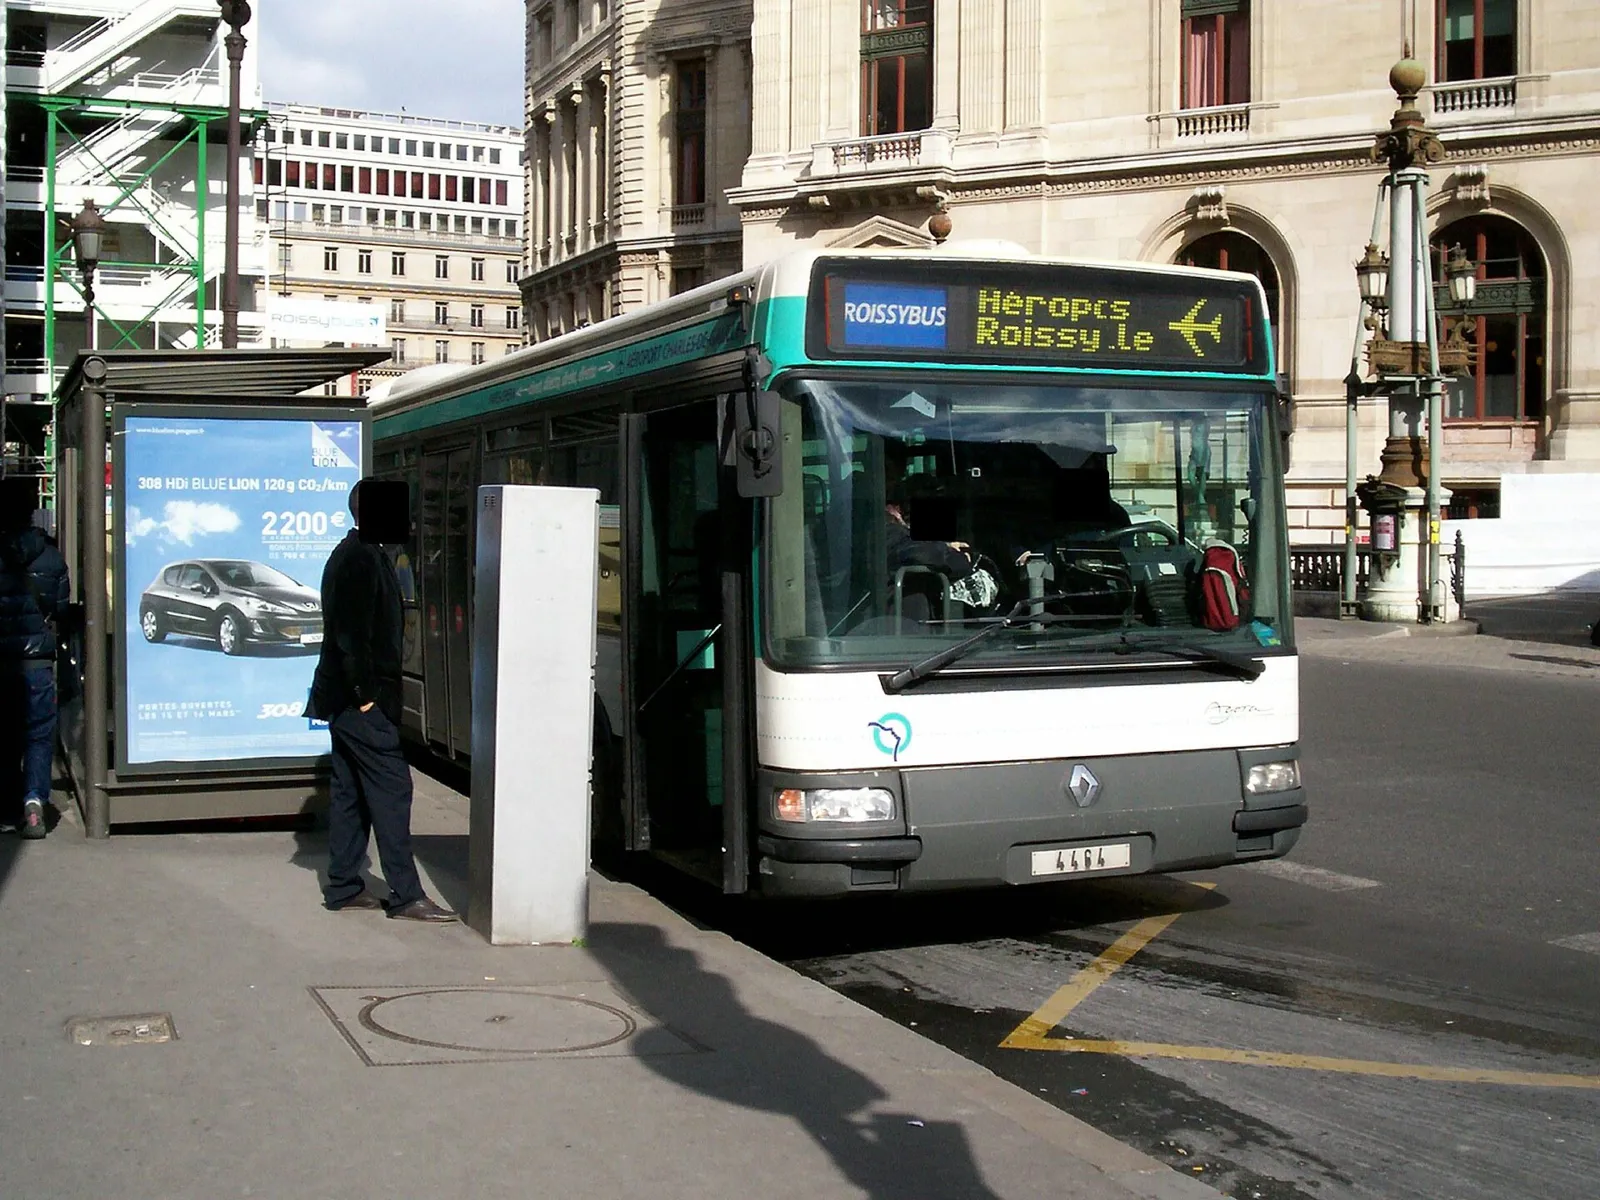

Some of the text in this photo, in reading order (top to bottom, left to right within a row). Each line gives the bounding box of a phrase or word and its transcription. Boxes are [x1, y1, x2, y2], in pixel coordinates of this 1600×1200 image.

[844, 302, 947, 326] ROISSYBUS
[977, 317, 1100, 352] Roissy
[312, 447, 338, 457] BLUE
[312, 457, 338, 468] LION
[138, 477, 162, 490] 308
[166, 478, 188, 490] HDi
[192, 478, 227, 491] BLUE
[229, 478, 259, 491] LION
[330, 511, 346, 528] €
[256, 701, 303, 719] 308
